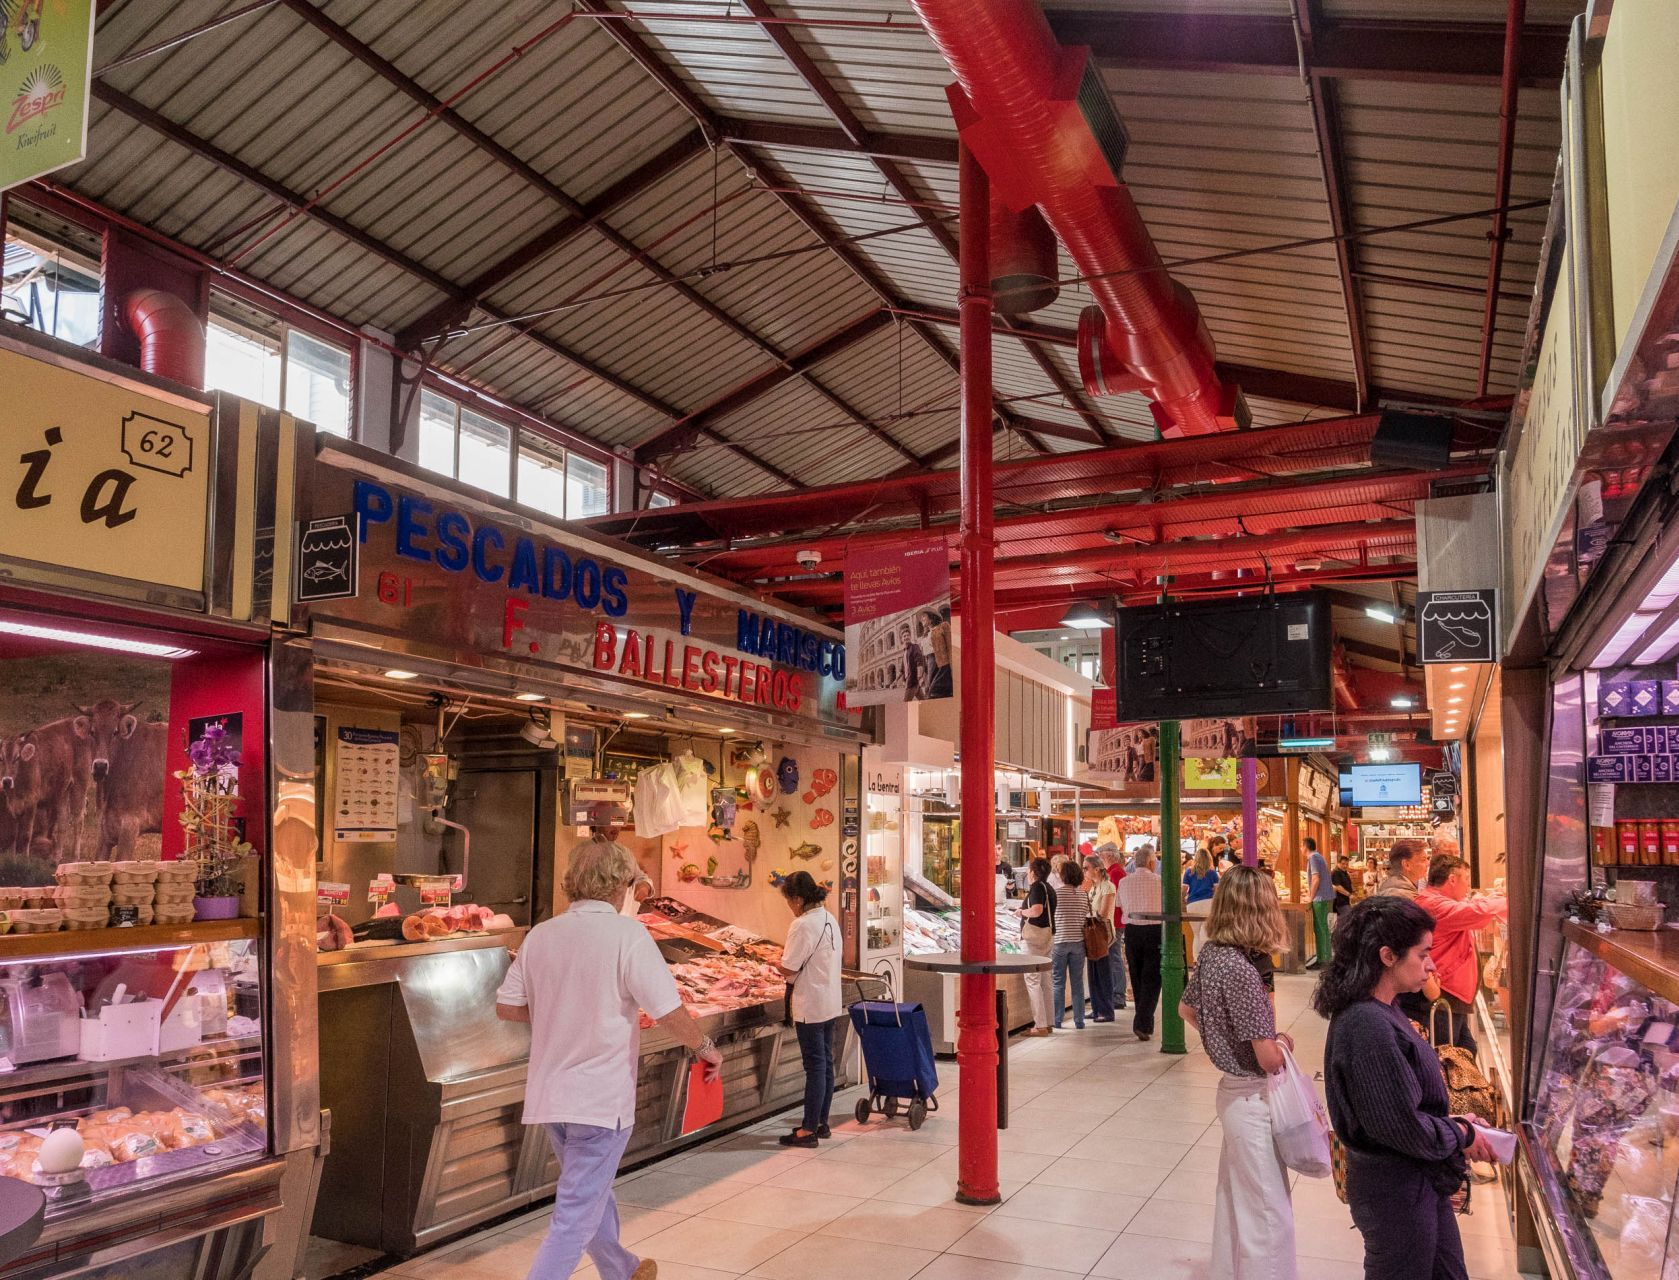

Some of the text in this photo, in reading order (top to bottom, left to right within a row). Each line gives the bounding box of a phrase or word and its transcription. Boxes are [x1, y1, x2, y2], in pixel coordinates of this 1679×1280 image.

[5, 83, 68, 135] Zespri
[16, 123, 57, 151] Kiwifruit
[140, 430, 174, 458] 62
[15, 427, 137, 529] ia
[904, 549, 924, 557] IBERIA
[355, 482, 846, 681] PESCADOS Y MARISCO
[379, 571, 412, 608] 61
[503, 598, 802, 712] F. BALLESTEROS
[868, 772, 876, 791] La
